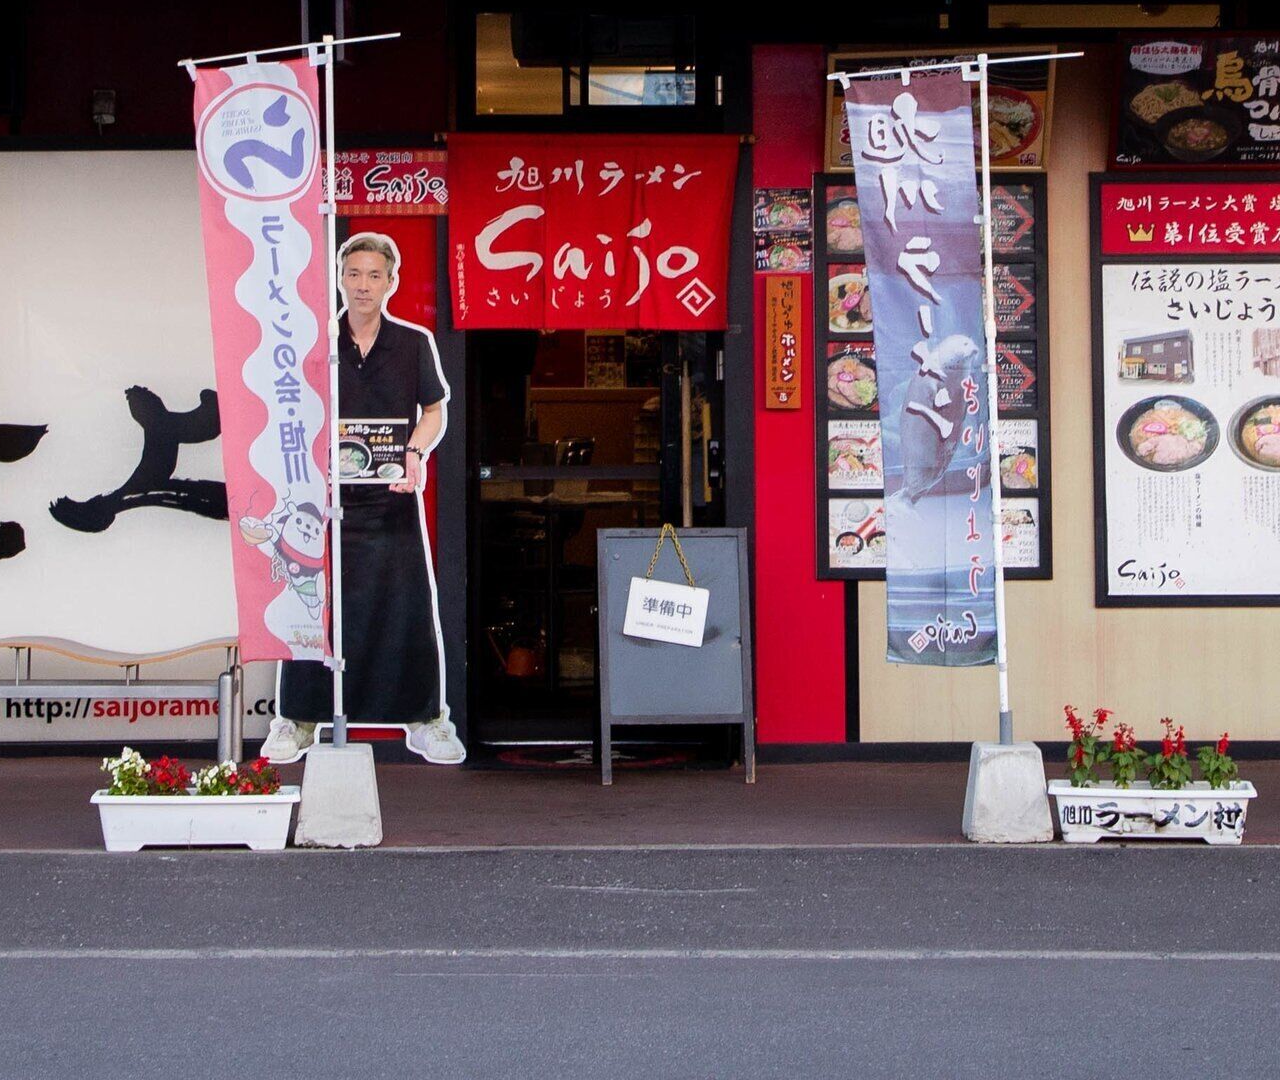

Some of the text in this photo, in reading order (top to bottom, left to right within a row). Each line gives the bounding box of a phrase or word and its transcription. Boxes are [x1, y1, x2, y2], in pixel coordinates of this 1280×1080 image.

[495, 156, 702, 197] 旭川ラーメン
[1117, 193, 1258, 213] 旭川ラーメン大賞
[474, 204, 700, 307] Saijo
[486, 286, 612, 309] さいじょう
[1166, 297, 1277, 322] さいじょう
[643, 596, 693, 619] 準備中
